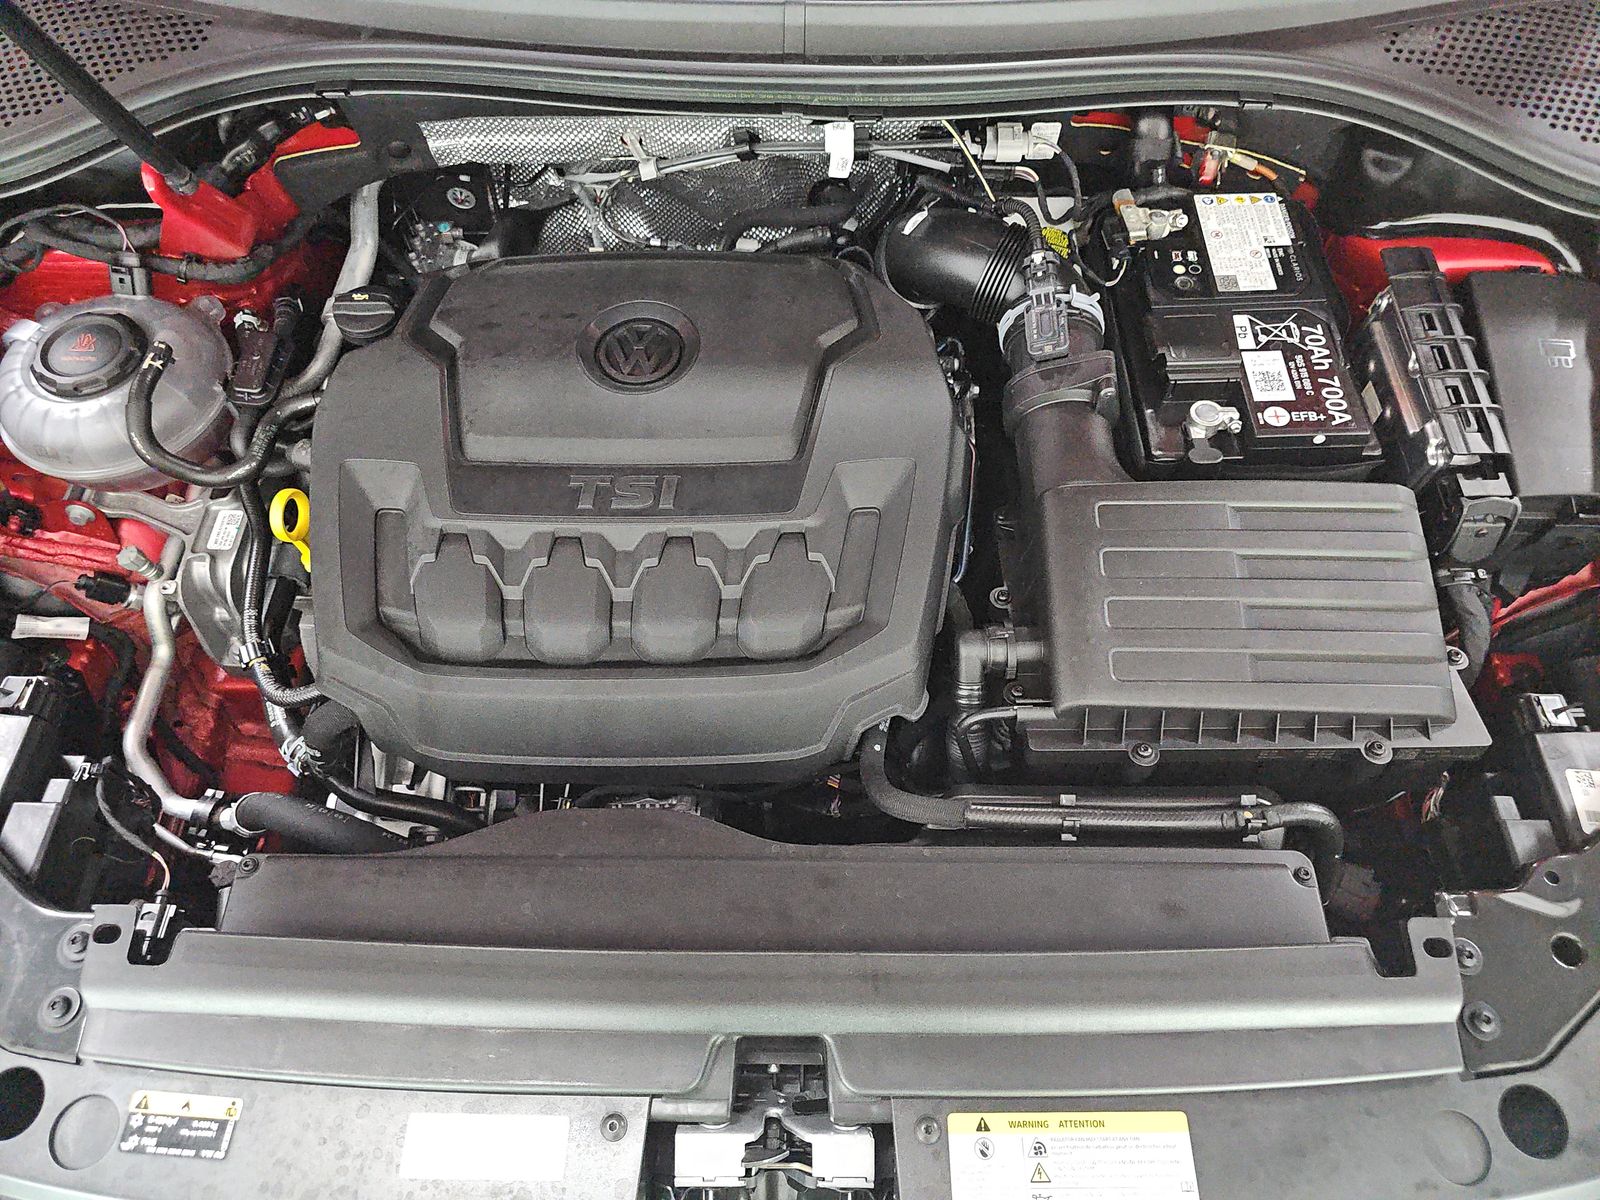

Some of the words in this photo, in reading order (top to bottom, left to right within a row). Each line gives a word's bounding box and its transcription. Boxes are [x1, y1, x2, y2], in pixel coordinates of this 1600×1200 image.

[1289, 254, 1304, 282] CLARIOS
[1236, 325, 1249, 339] Pb
[1301, 324, 1333, 370] 70Ah
[1317, 375, 1352, 426] 700A
[1291, 411, 1327, 422] EFB+
[569, 475, 681, 510] TSI
[1008, 1120, 1049, 1128] WARNING
[1058, 1120, 1105, 1128] ATTENTION
